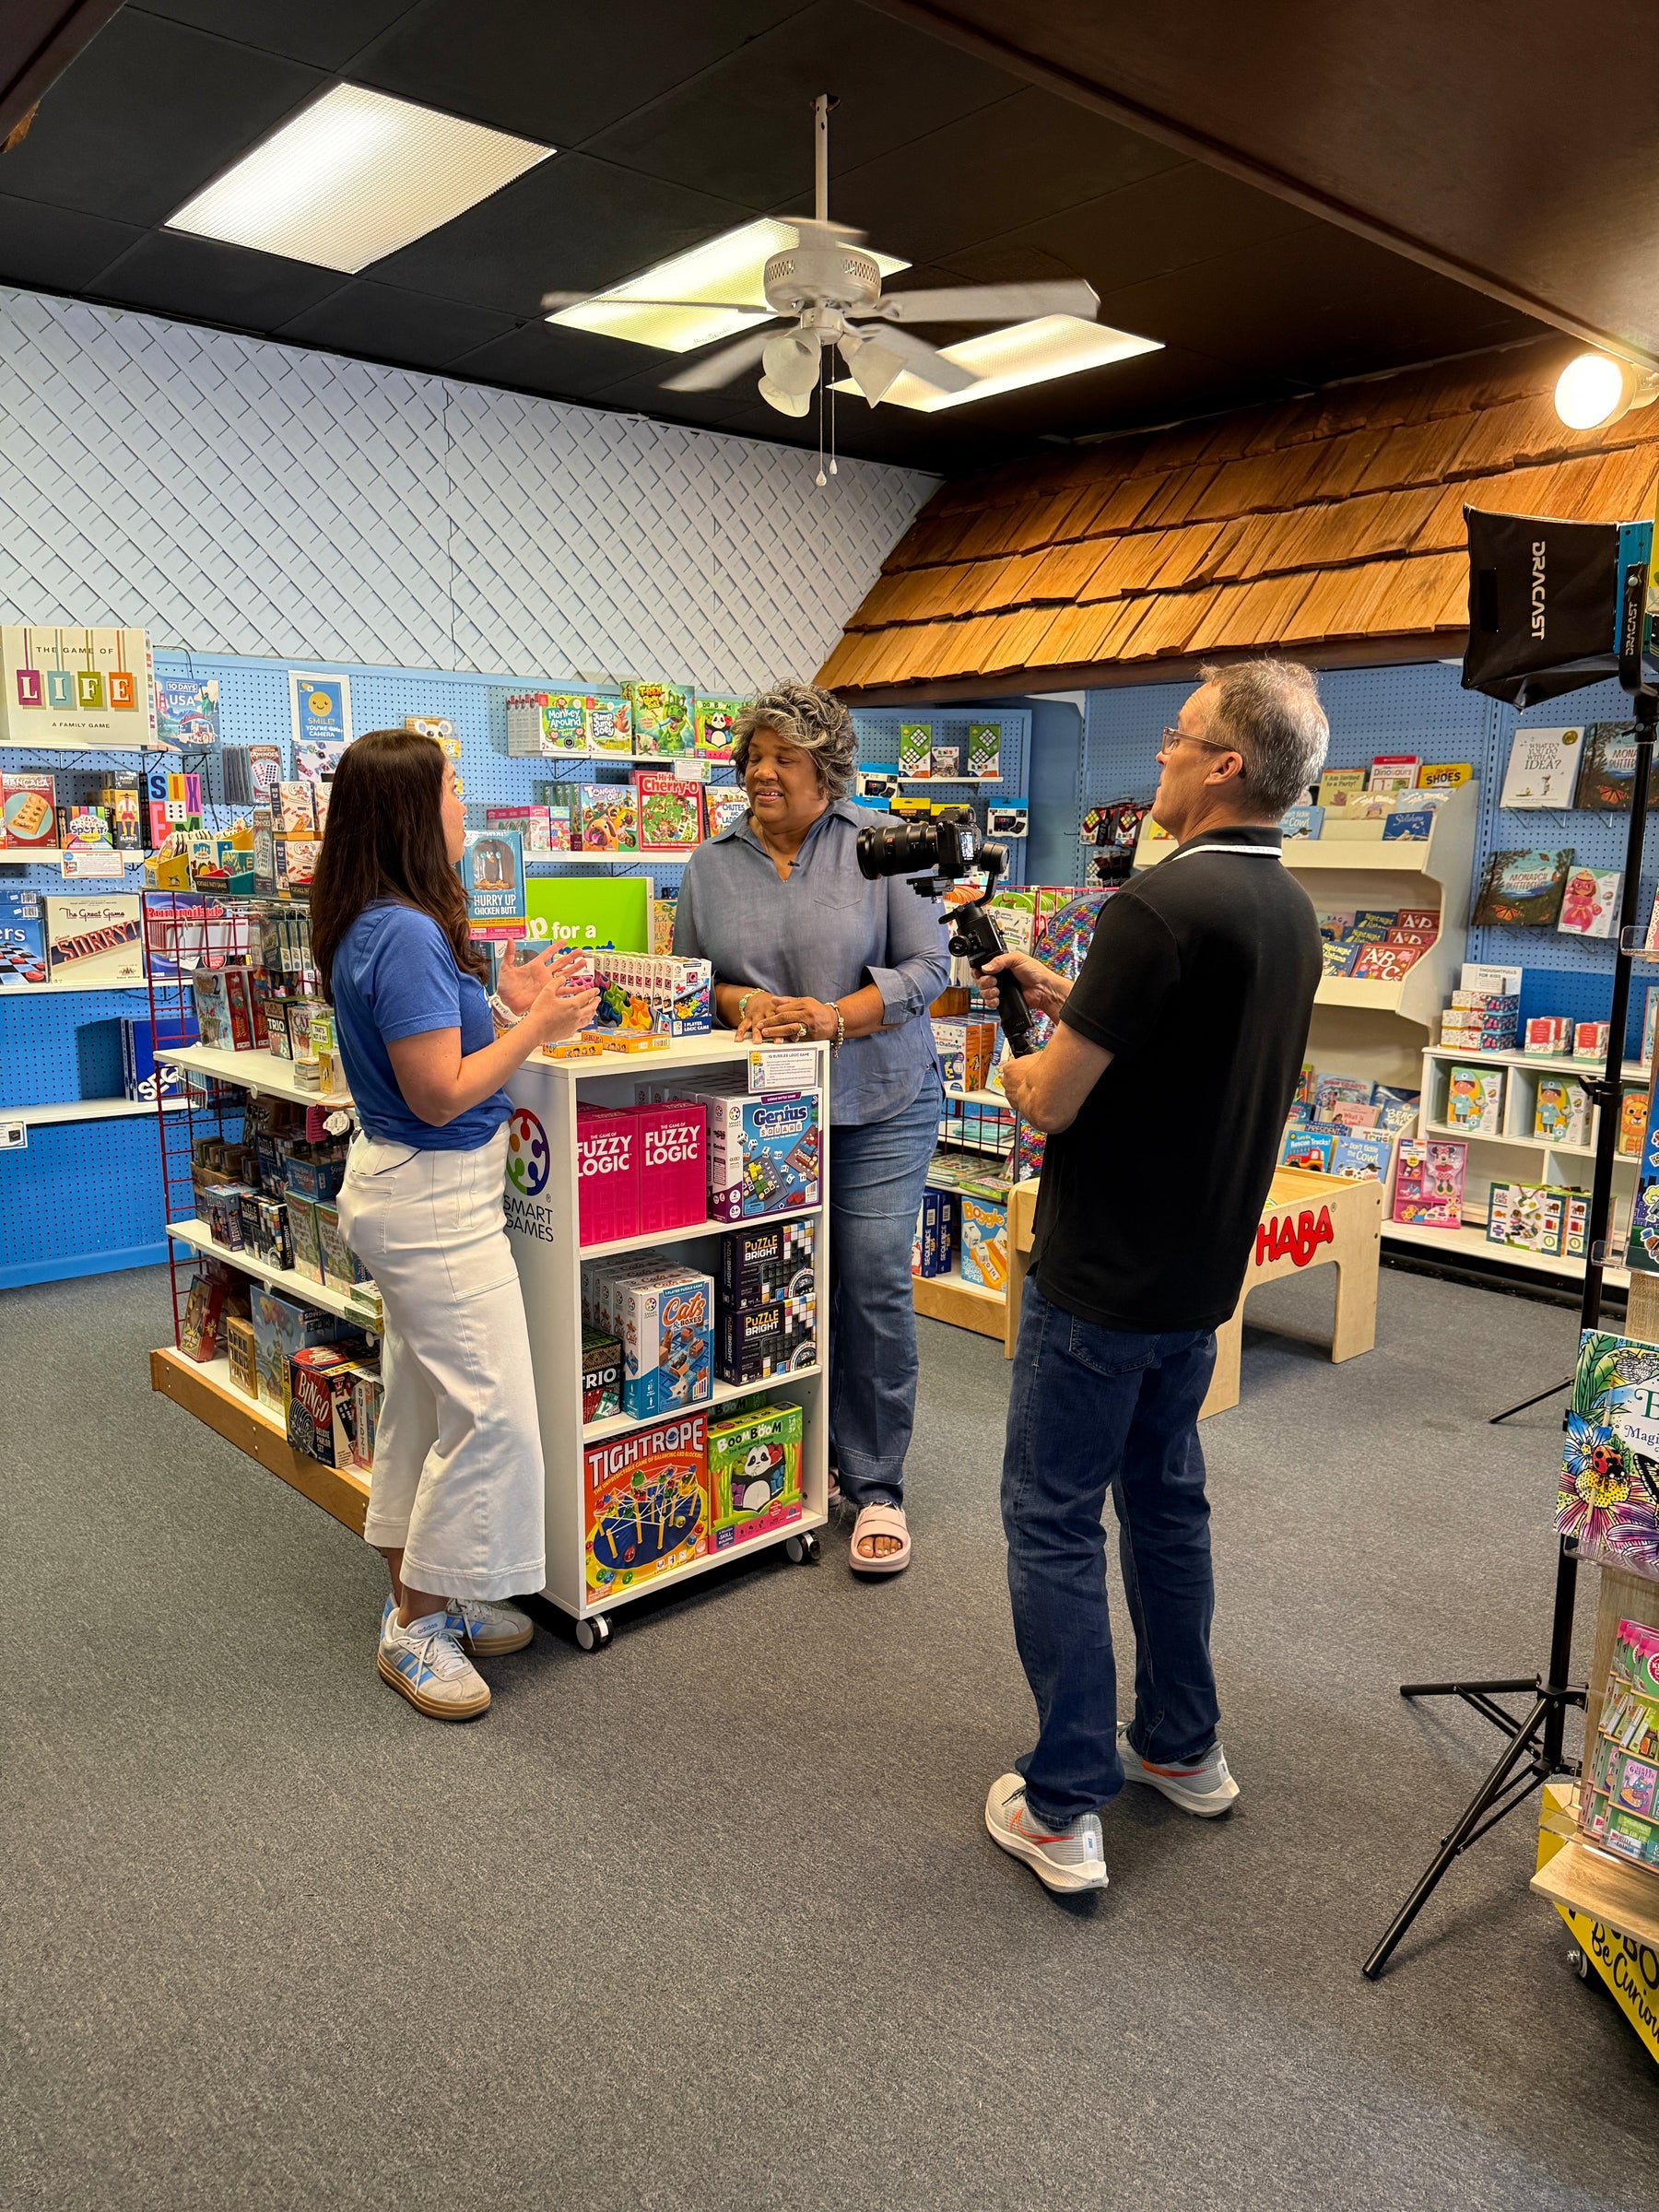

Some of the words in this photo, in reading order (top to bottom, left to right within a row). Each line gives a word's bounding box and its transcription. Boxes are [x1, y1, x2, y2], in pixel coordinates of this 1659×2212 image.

[1530, 541, 1547, 641] DRACAST
[1624, 601, 1640, 657] DRACAST
[19, 676, 131, 702] LIFE
[178, 683, 197, 691] DAYS
[169, 693, 195, 707] USA
[307, 717, 335, 725] SMILE!
[548, 708, 581, 720] Monkey
[550, 717, 582, 728] Around
[1611, 748, 1638, 759] MONA
[1373, 768, 1413, 777] Dinosaurs
[1524, 759, 1562, 771] IDEA?
[642, 778, 700, 794] Cherry-O
[1426, 772, 1461, 785] SHOES
[150, 775, 201, 814] SIX
[1288, 818, 1310, 828] Cow!
[1509, 872, 1548, 882] MONARCH
[474, 894, 502, 907] HURRY
[504, 893, 516, 906] UP
[59, 907, 77, 919] The
[79, 909, 101, 922] Great
[102, 908, 125, 921] Game
[147, 904, 224, 918] Rummikub
[474, 906, 500, 915] CHICKEN
[500, 906, 516, 915] BUTT
[0, 927, 27, 942] rs
[552, 922, 577, 939] for
[585, 924, 597, 938] a
[56, 920, 140, 962] SORRY!
[266, 1018, 285, 1031] TRIO
[939, 1041, 962, 1049] Challenge
[754, 1104, 808, 1126] Genius
[645, 1124, 700, 1148] FUZZY
[760, 1124, 803, 1136] SQUARE
[1307, 1124, 1341, 1135] PRESIDENT
[577, 1135, 632, 1159] FUZZY
[1311, 1137, 1332, 1146] Trucks!
[1348, 1142, 1362, 1150] Don't
[645, 1144, 698, 1167] LOGIC
[1356, 1150, 1379, 1163] Cow!
[578, 1154, 630, 1177] LOGIC
[503, 1194, 554, 1225] SMART
[961, 1200, 1006, 1229] Boggle
[504, 1213, 554, 1242] GAMES
[1255, 1206, 1334, 1266] HABA
[744, 1235, 779, 1253] PUZZLE
[744, 1246, 779, 1262] BRIGHT
[662, 1292, 707, 1327] Cats
[680, 1316, 702, 1327] BOXES
[745, 1309, 780, 1328] PUZZLE
[745, 1320, 780, 1337] BRIGHT
[298, 1370, 331, 1423] BINGO
[588, 1418, 705, 1490] TIGHTROPE
[593, 1484, 603, 1495] THE
[602, 1463, 636, 1488] UNPREDICTABLE
[636, 1458, 649, 1468] GAME
[654, 1452, 677, 1462] BALANCING
[685, 1451, 703, 1459] BLOCKING
[417, 1621, 440, 1636] adidas
[1592, 1920, 1614, 1969] Be
